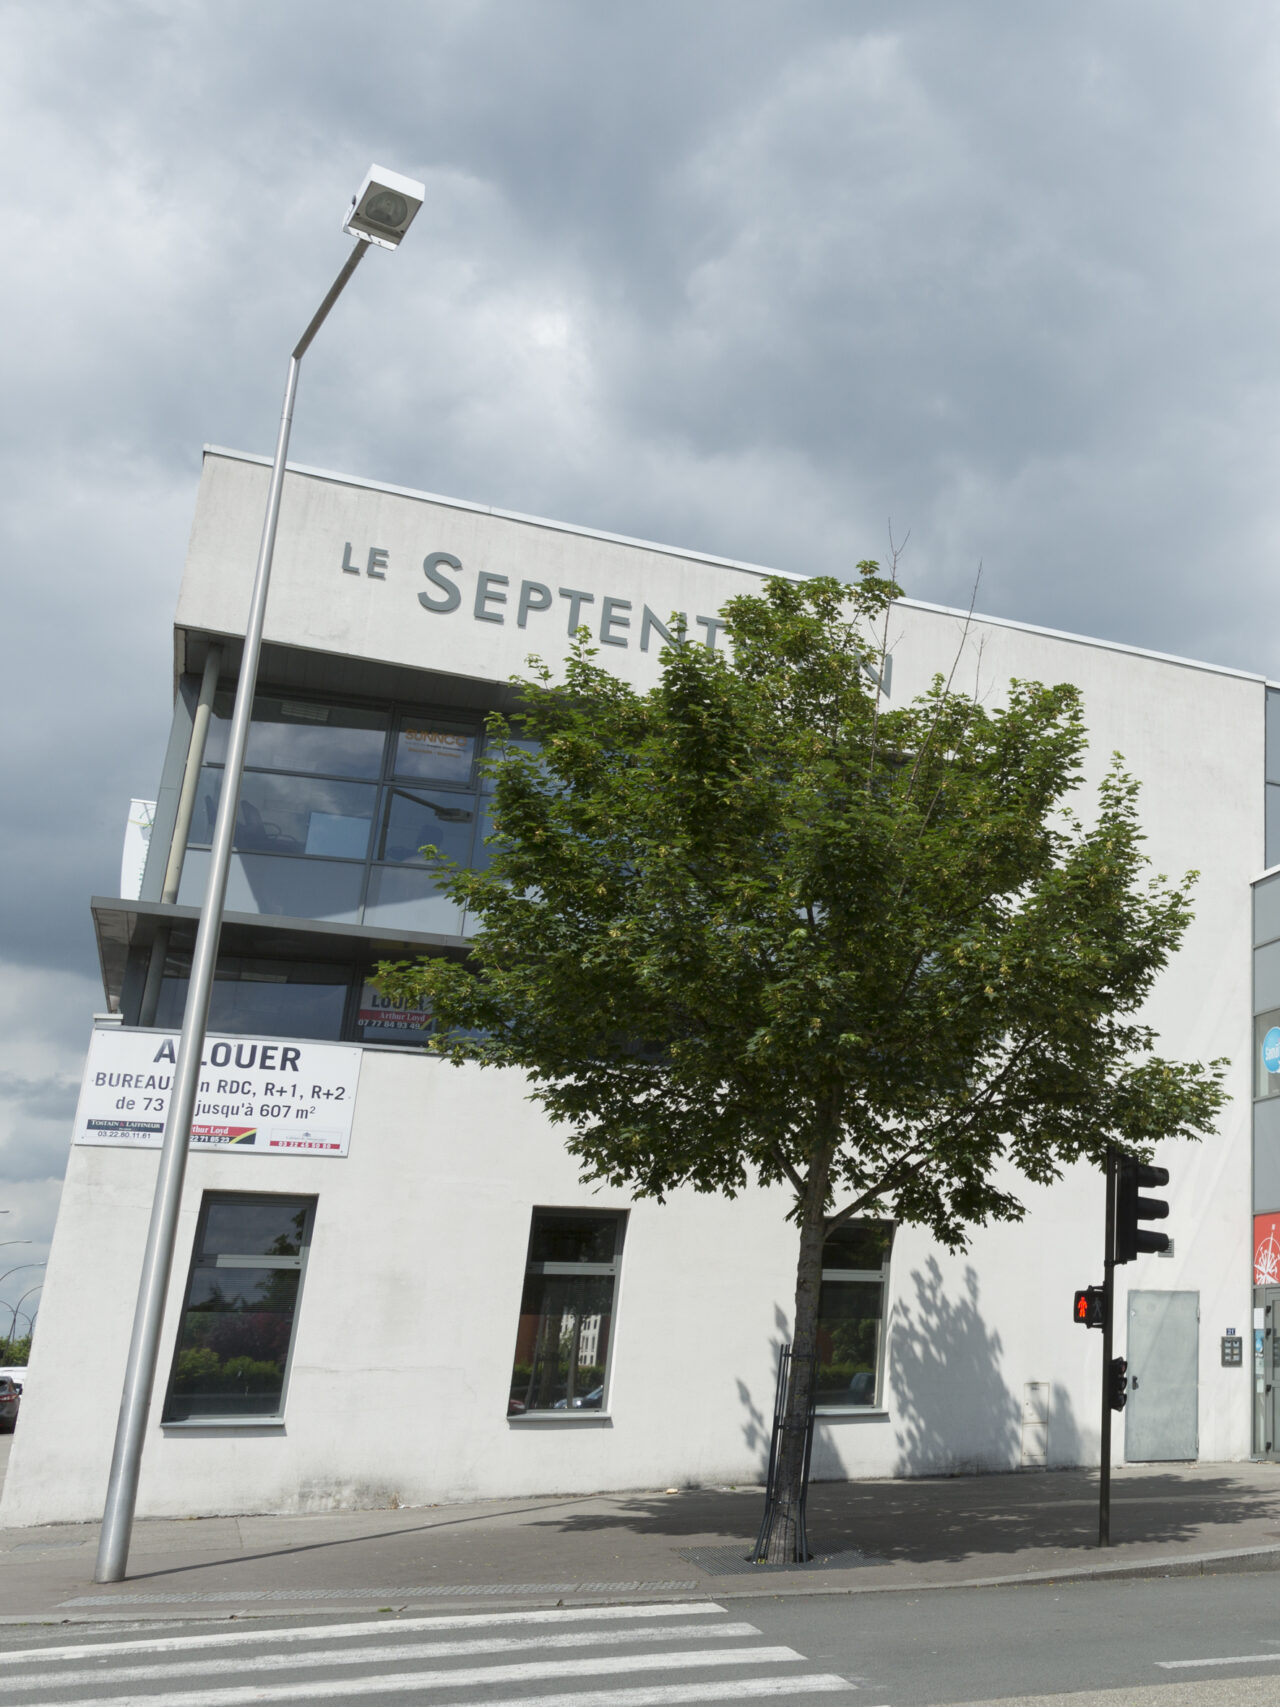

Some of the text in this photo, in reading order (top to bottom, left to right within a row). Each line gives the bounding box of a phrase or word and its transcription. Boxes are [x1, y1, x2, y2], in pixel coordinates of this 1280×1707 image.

[342, 542, 893, 699] LE SEPTENTN
[380, 1012, 426, 1023] Arthur Loyd
[153, 1039, 301, 1072] A OUER
[95, 1072, 175, 1091] BUREAU
[217, 1079, 257, 1098] RDC,
[264, 1082, 304, 1101] R+1,
[311, 1085, 346, 1100] R+2
[115, 1096, 135, 1110] de
[143, 1097, 165, 1111] 73
[194, 1100, 254, 1118] jusqu'à
[259, 1104, 292, 1118] 607
[210, 1126, 229, 1135] Loyd
